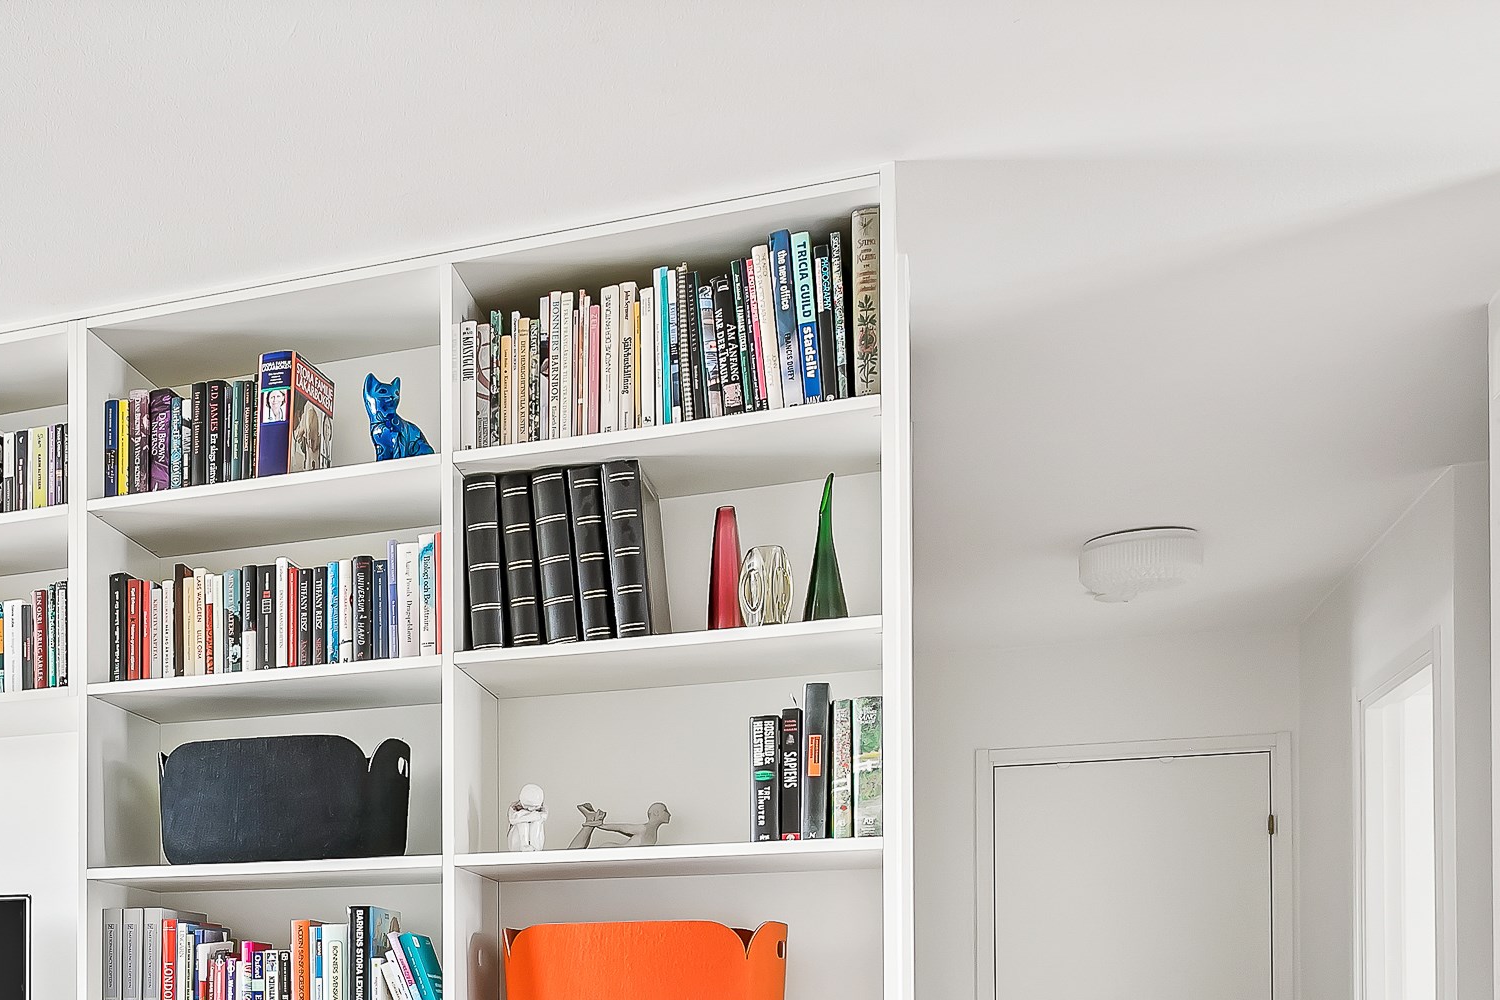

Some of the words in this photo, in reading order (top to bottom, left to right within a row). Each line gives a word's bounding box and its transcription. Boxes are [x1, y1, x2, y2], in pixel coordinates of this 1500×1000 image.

[777, 250, 787, 264] the
[796, 242, 809, 281] TRICIA
[779, 265, 788, 283] new
[821, 257, 831, 311] PHOTOGRAPHY
[780, 286, 790, 310] office
[800, 284, 812, 318] GUILD
[714, 309, 723, 330] WAR
[726, 324, 736, 340] AM
[716, 333, 724, 348] DER
[784, 333, 792, 360] FRANCIS
[803, 326, 817, 378] stadsliv
[296, 363, 314, 385] STORA
[621, 337, 632, 394] Självhushållning
[728, 343, 740, 381] ANFANG
[786, 362, 795, 381] DUFFY
[296, 374, 333, 413] LÄKARBOKEN
[158, 413, 166, 430] DAN
[209, 403, 218, 432] JAMES
[158, 433, 166, 462] BROWN
[208, 445, 218, 462] slags
[422, 556, 430, 580] Biologi
[300, 581, 308, 610] TIFFANY
[357, 572, 365, 612] UNIVERSUM
[423, 594, 431, 632] Bosättning
[357, 622, 365, 646] HAND
[753, 721, 765, 766] HELLSTRÖM
[764, 720, 774, 756] ROSLUND
[764, 757, 774, 765] &
[784, 752, 797, 788] SAPIENS
